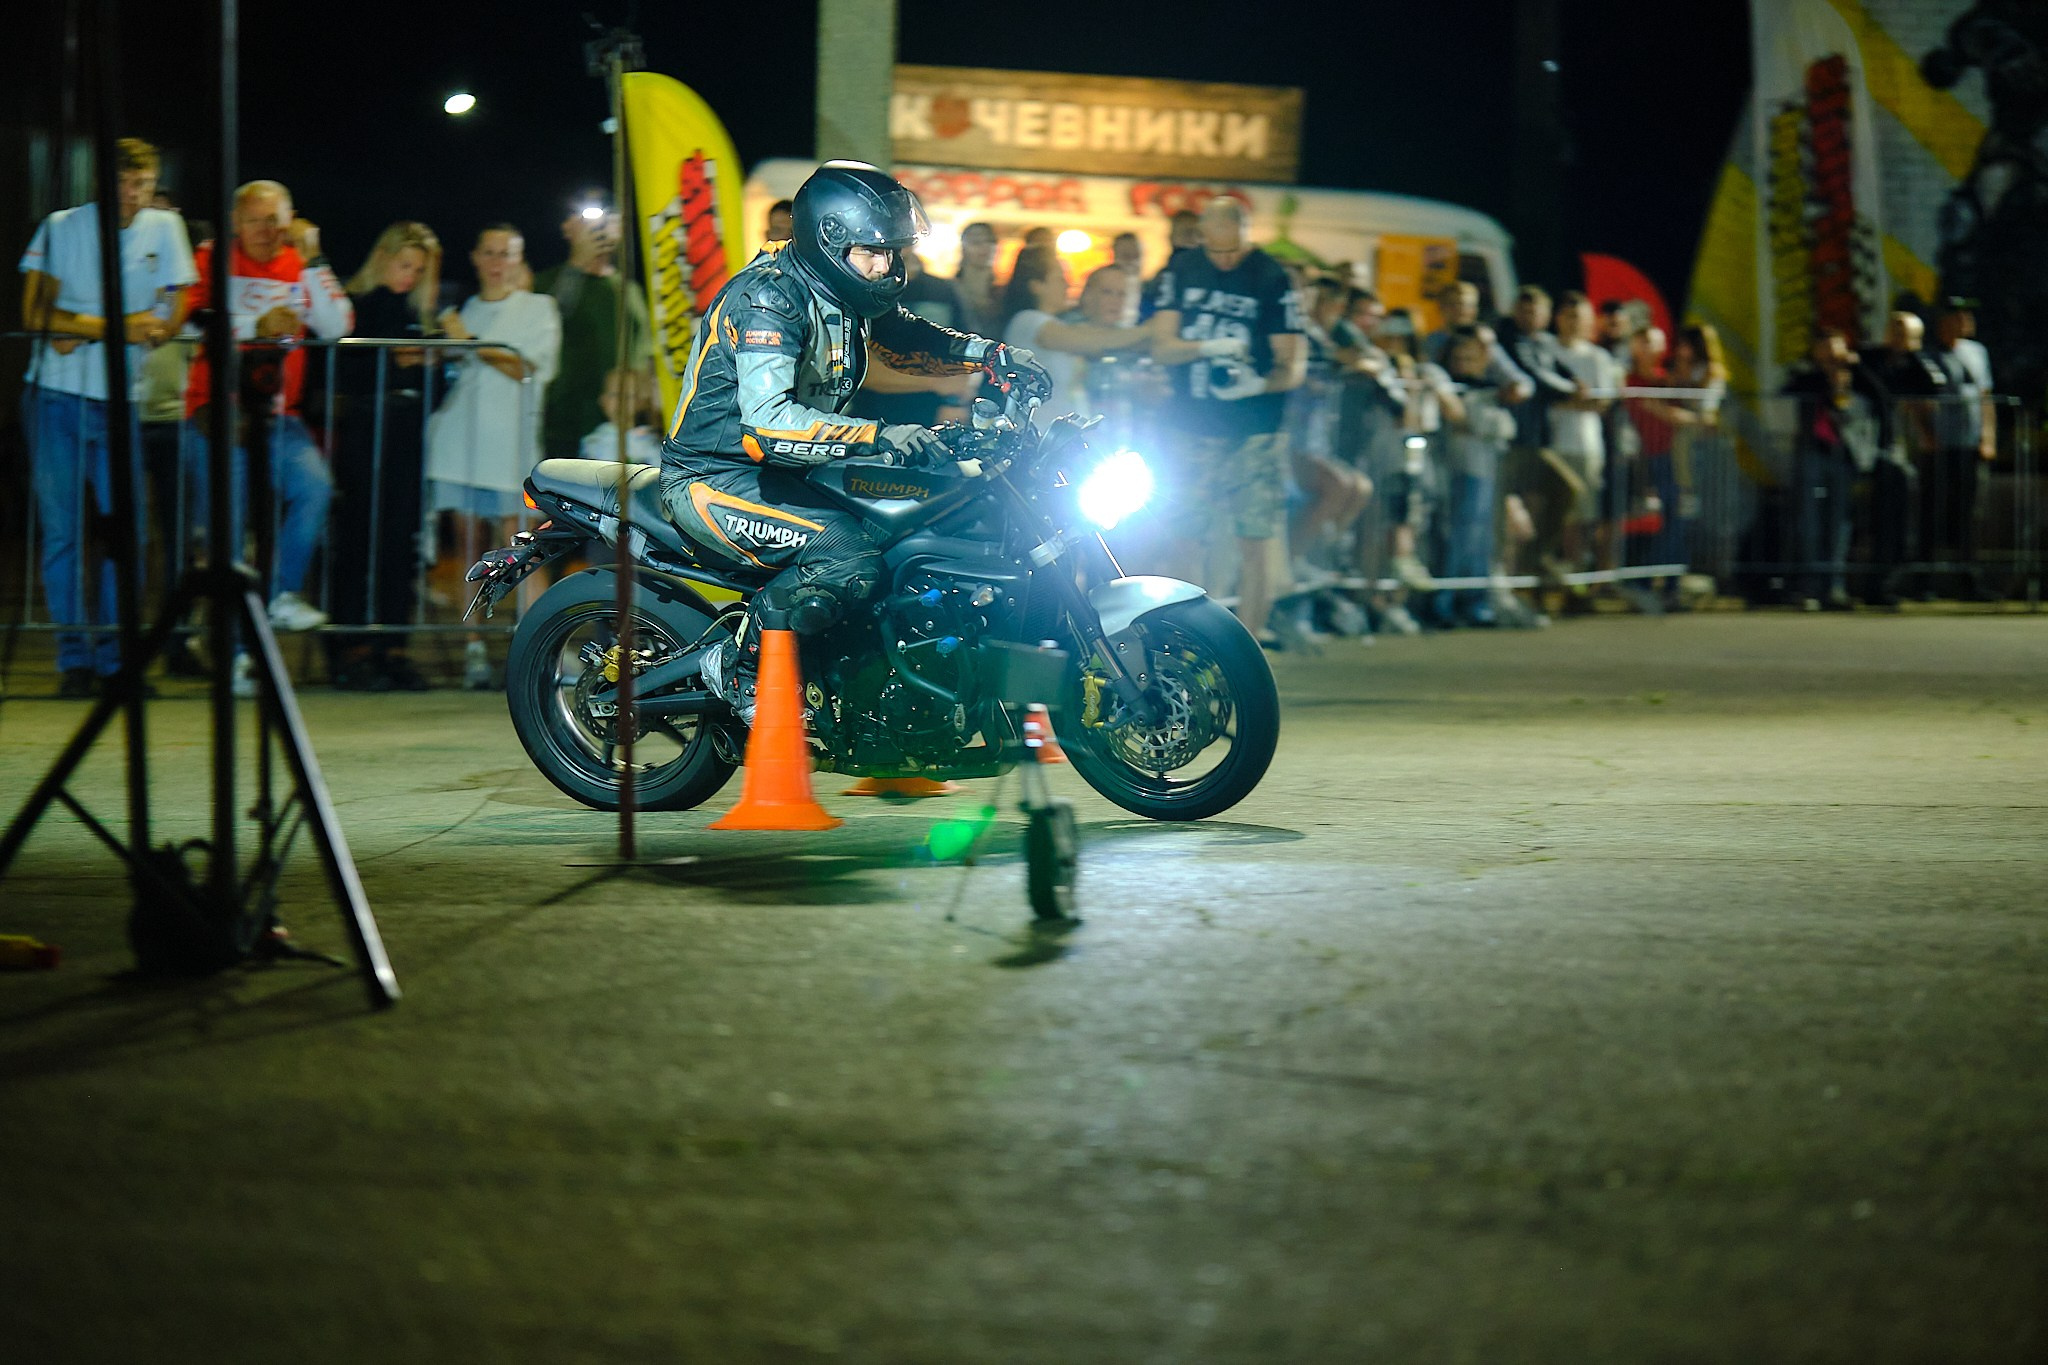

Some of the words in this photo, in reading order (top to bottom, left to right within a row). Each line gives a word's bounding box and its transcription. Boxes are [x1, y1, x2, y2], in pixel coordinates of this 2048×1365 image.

[773, 441, 846, 457] BERG
[850, 478, 930, 499] TRIUMPH
[725, 514, 808, 549] TRIUMPH
